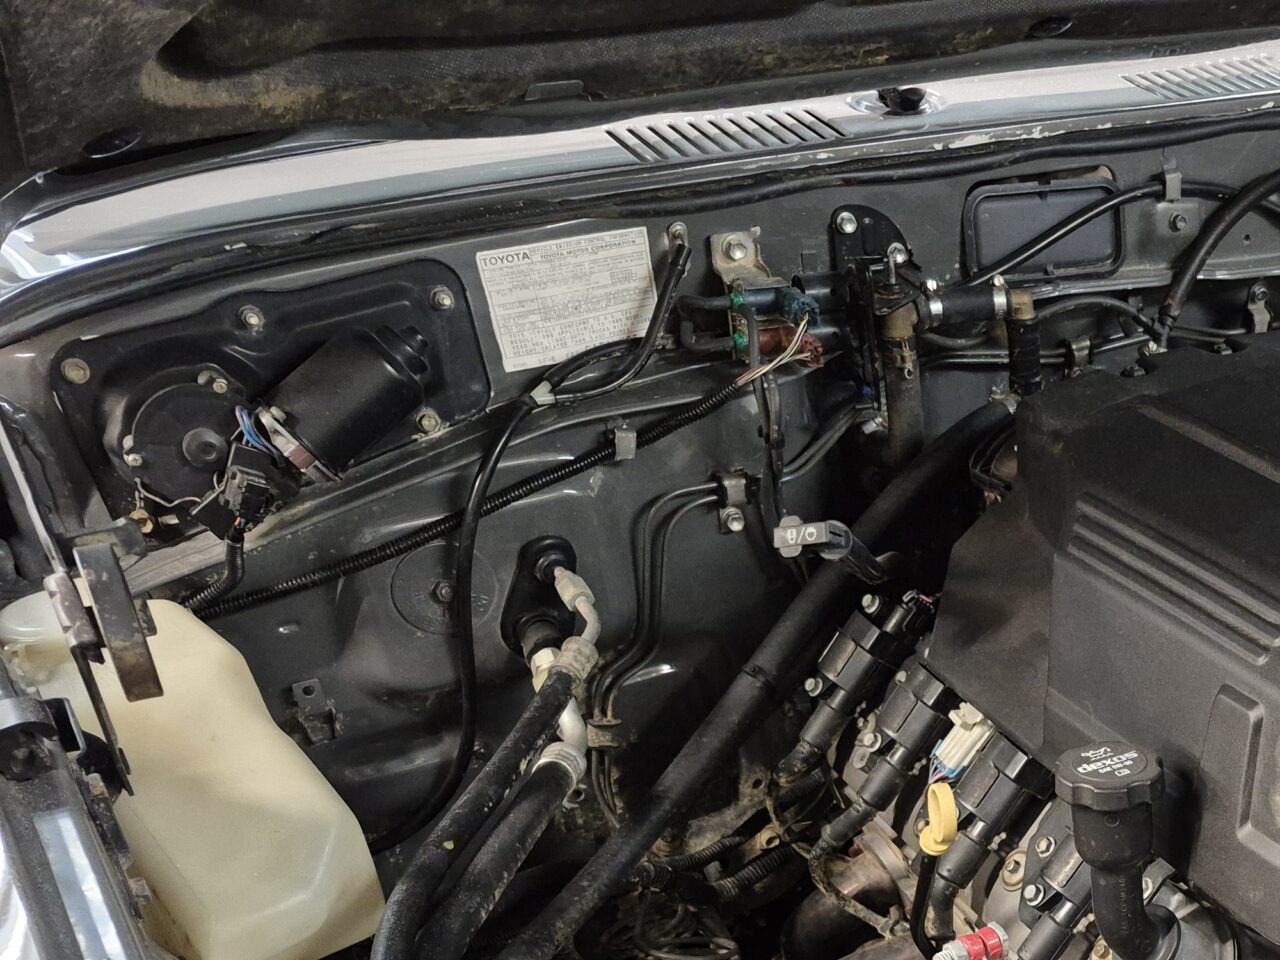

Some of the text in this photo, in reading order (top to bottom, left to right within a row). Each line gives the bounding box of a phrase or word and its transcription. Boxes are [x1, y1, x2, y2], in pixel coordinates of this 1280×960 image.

[481, 250, 530, 267] TOYOTA
[540, 251, 564, 260] TOYOTA
[590, 238, 636, 252] CORPORATION
[1077, 750, 1138, 773] dexos
